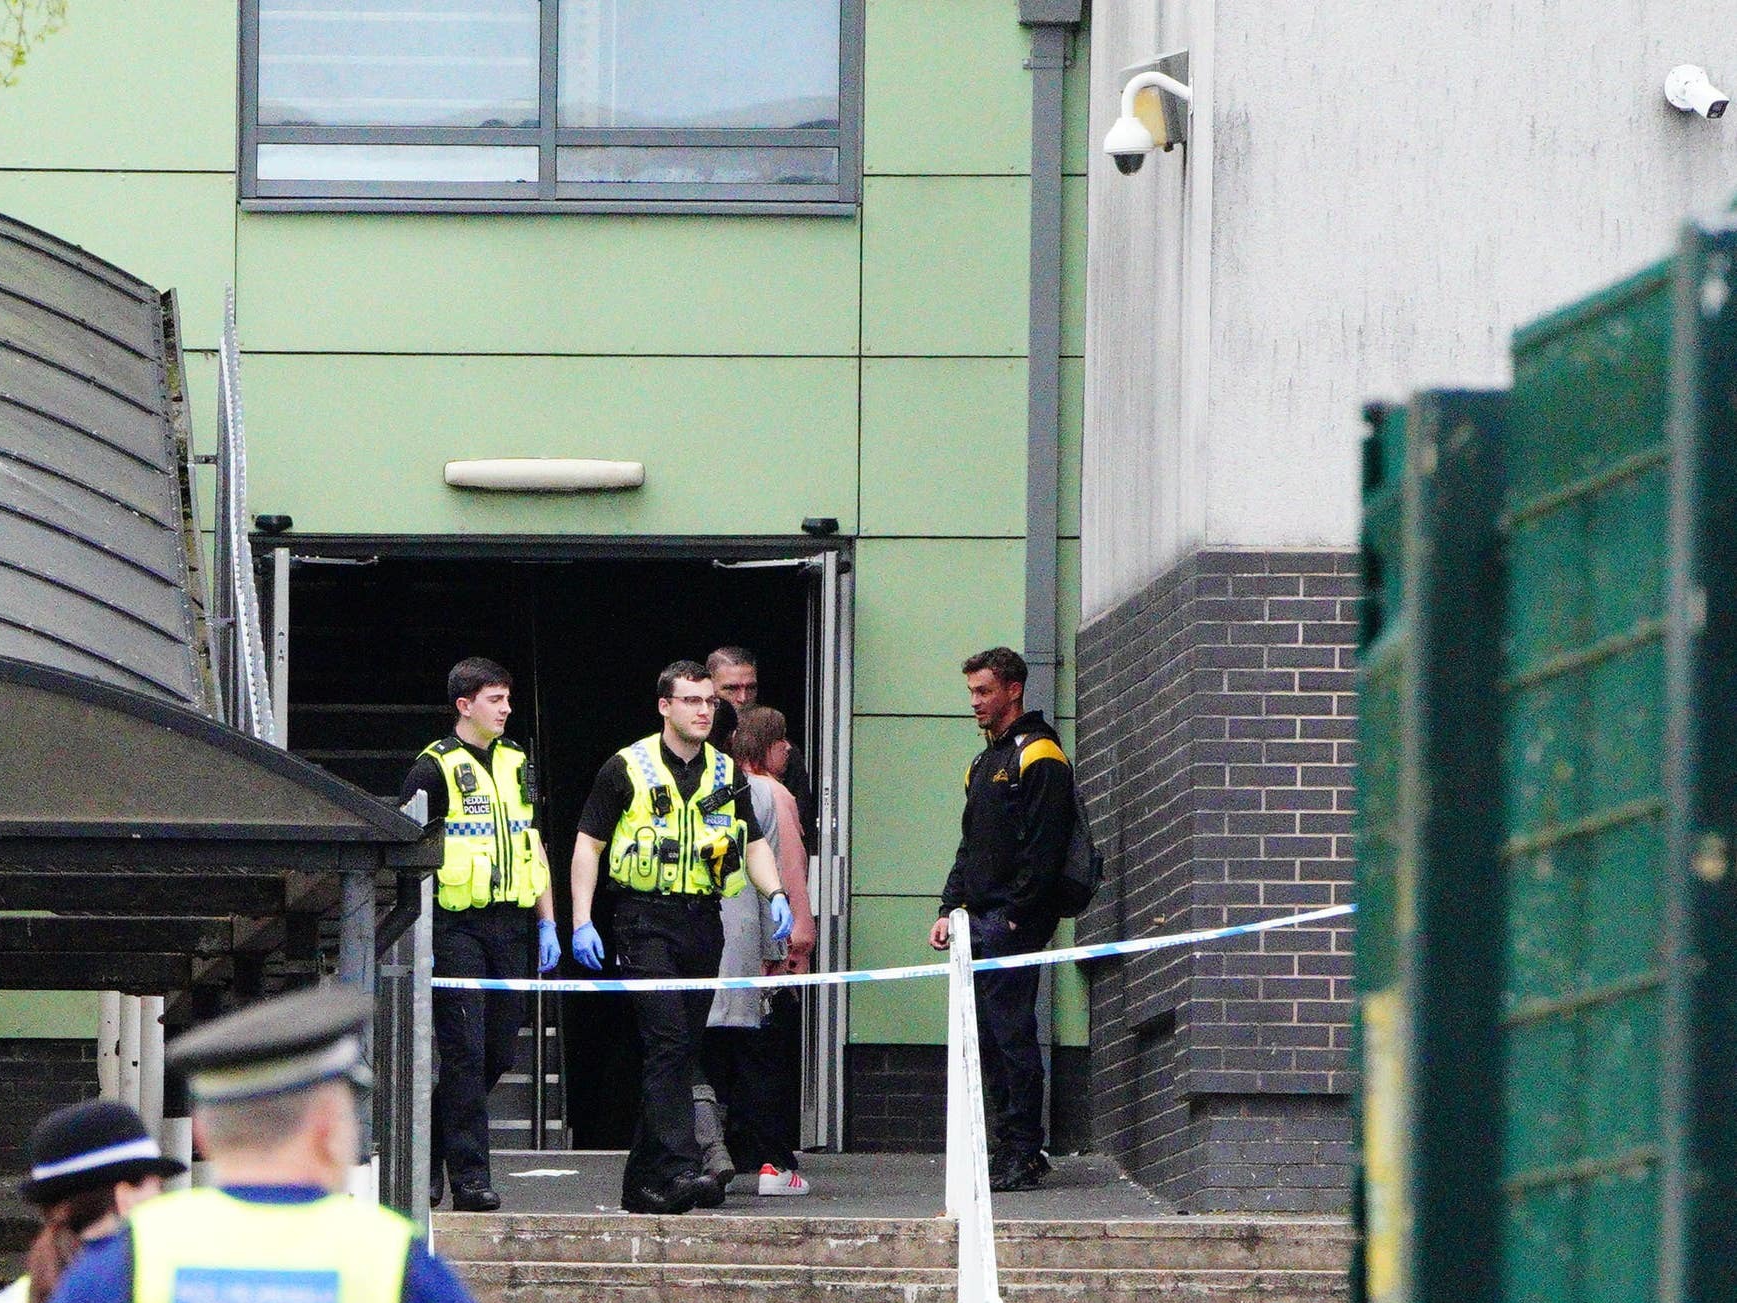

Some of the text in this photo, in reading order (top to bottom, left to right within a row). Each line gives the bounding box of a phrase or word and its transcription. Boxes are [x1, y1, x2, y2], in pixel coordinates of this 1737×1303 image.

[463, 796, 489, 805] HEDDLU
[464, 805, 490, 814] POLICE
[706, 816, 728, 826] POLICE
